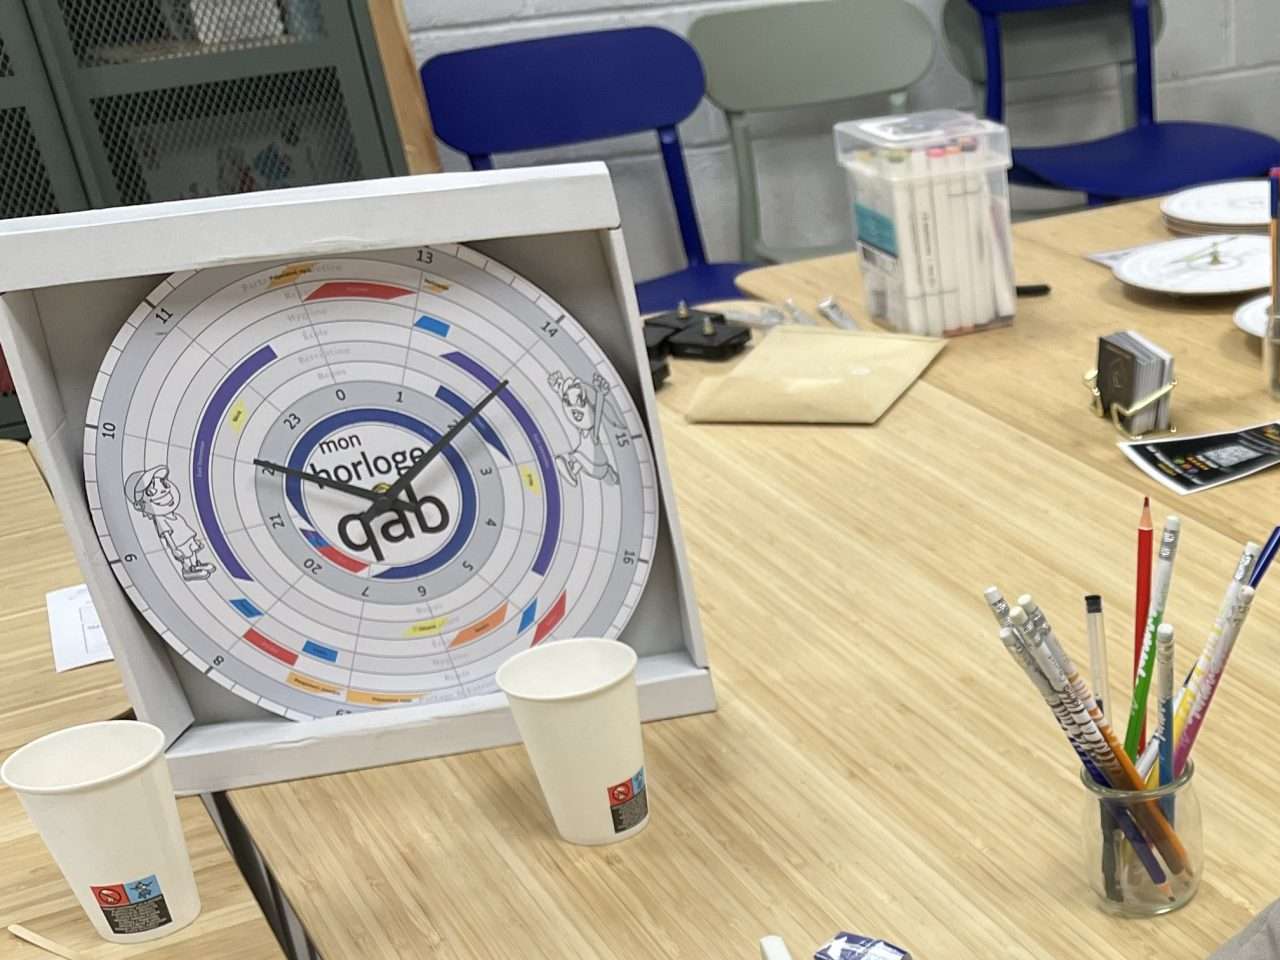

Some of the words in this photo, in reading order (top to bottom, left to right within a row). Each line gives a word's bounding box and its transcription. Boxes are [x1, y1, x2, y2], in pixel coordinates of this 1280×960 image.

[416, 249, 433, 265] 13
[155, 307, 174, 324] 11
[540, 321, 559, 338] 14
[335, 388, 346, 401] 0
[396, 391, 403, 403] 1
[283, 412, 302, 430] 23
[102, 422, 116, 440] 10
[318, 433, 362, 454] mon
[615, 432, 630, 448] 15
[310, 445, 428, 489] horloge
[481, 467, 493, 476] 3
[269, 512, 285, 530] 21
[337, 484, 450, 562] qab
[485, 518, 497, 528] 4
[462, 560, 475, 572] 5
[623, 551, 636, 565] 16
[303, 557, 323, 576] 20
[213, 655, 225, 668] 8
